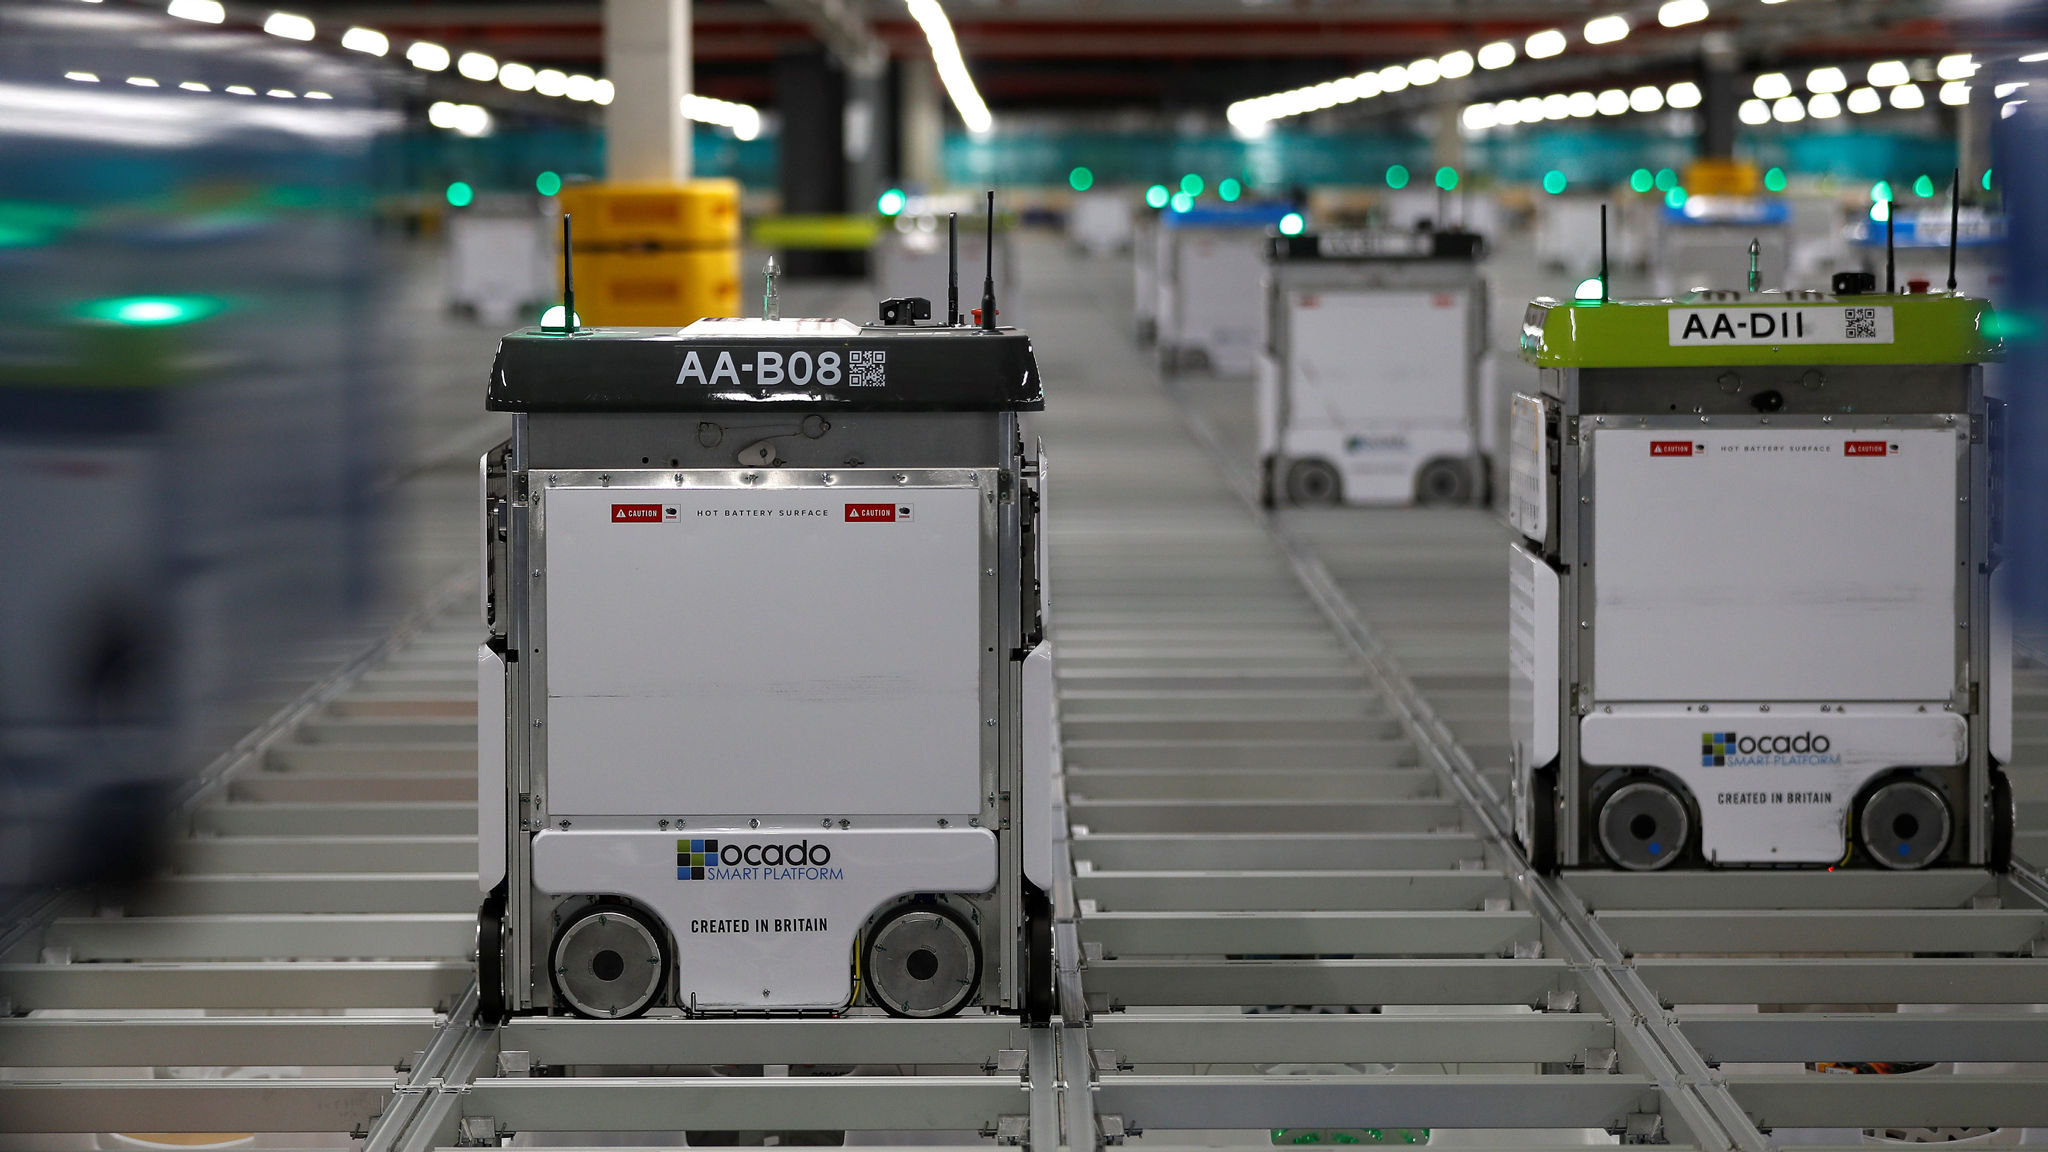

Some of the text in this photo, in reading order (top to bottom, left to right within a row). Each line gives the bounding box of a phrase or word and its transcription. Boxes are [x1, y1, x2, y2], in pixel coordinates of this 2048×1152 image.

[675, 350, 842, 386] AA-B08
[1663, 445, 1688, 453] CAUTION
[1788, 445, 1831, 453] SURFACE
[1857, 445, 1882, 453] CAUTION
[628, 509, 658, 517] CAUTION
[696, 509, 828, 517] HOT BATTERY SURFACE
[861, 509, 891, 517] CAUTION
[1737, 731, 1830, 755] ocado
[1726, 753, 1841, 767] SMART PLATFORM
[1717, 791, 1833, 805] CREATED IN BRITAIN
[720, 839, 831, 867] ocado
[707, 867, 844, 881] SMART PLATFORM
[691, 917, 828, 934] CREATED IN BRITAIN
